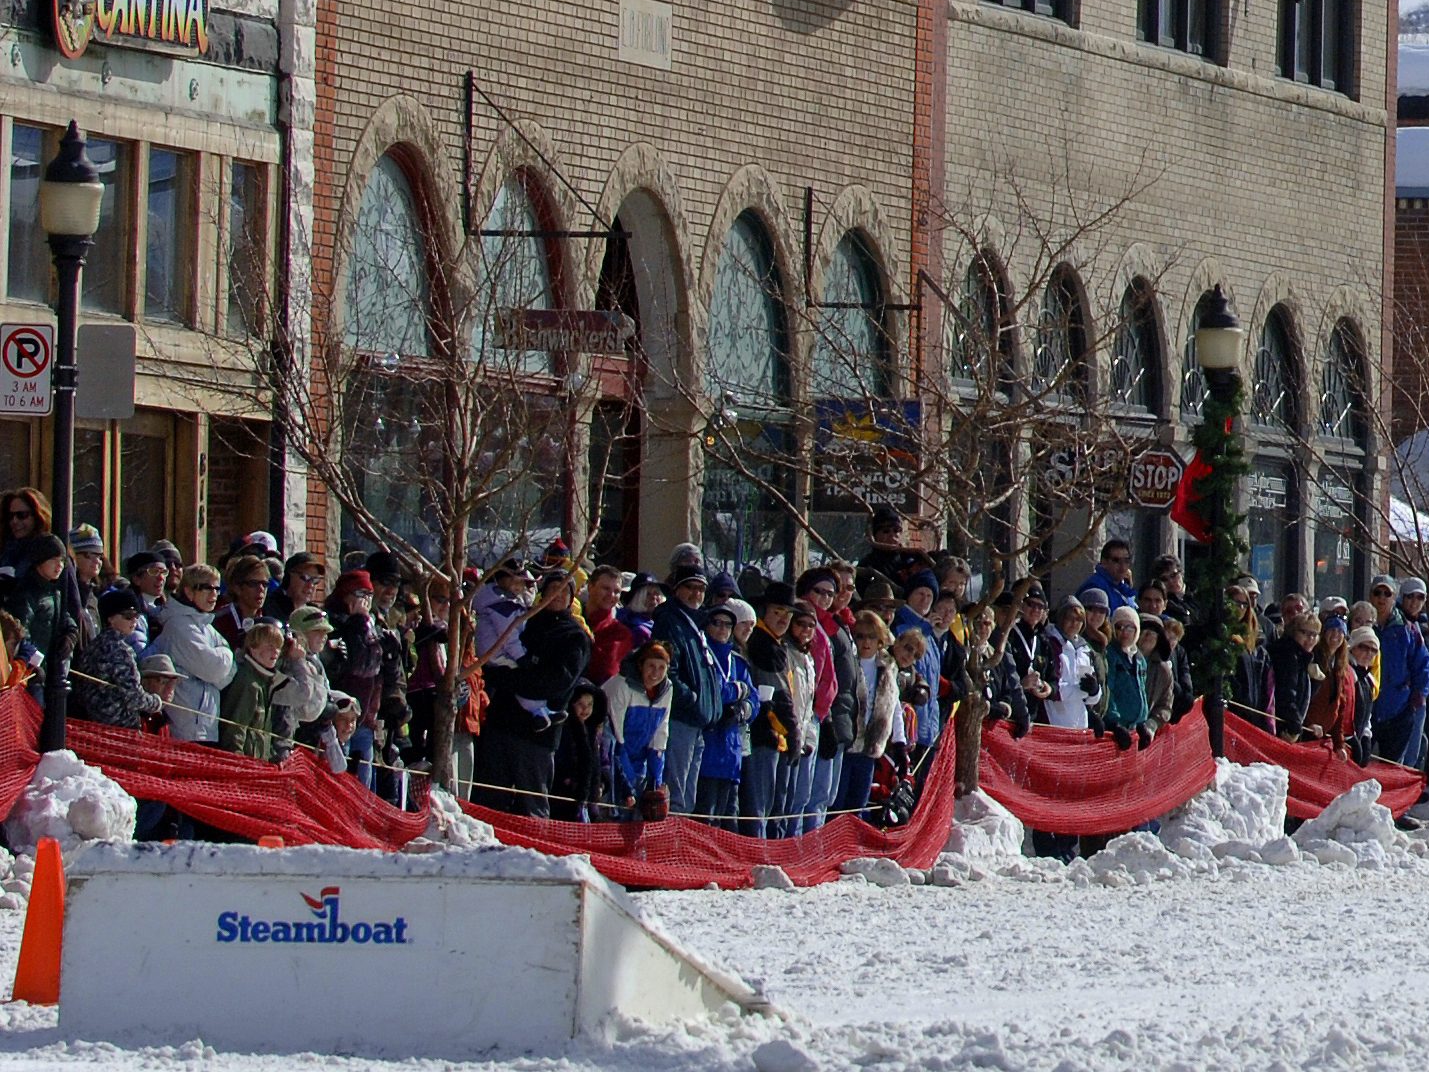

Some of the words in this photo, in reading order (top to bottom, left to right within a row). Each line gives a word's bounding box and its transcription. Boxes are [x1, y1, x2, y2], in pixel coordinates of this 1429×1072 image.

[12, 380, 19, 393] 3
[22, 381, 37, 393] AM
[4, 394, 15, 407] TO
[19, 395, 26, 407] 6
[30, 396, 44, 407] AM
[1134, 464, 1179, 491] STOP
[217, 897, 408, 944] Steamboat
